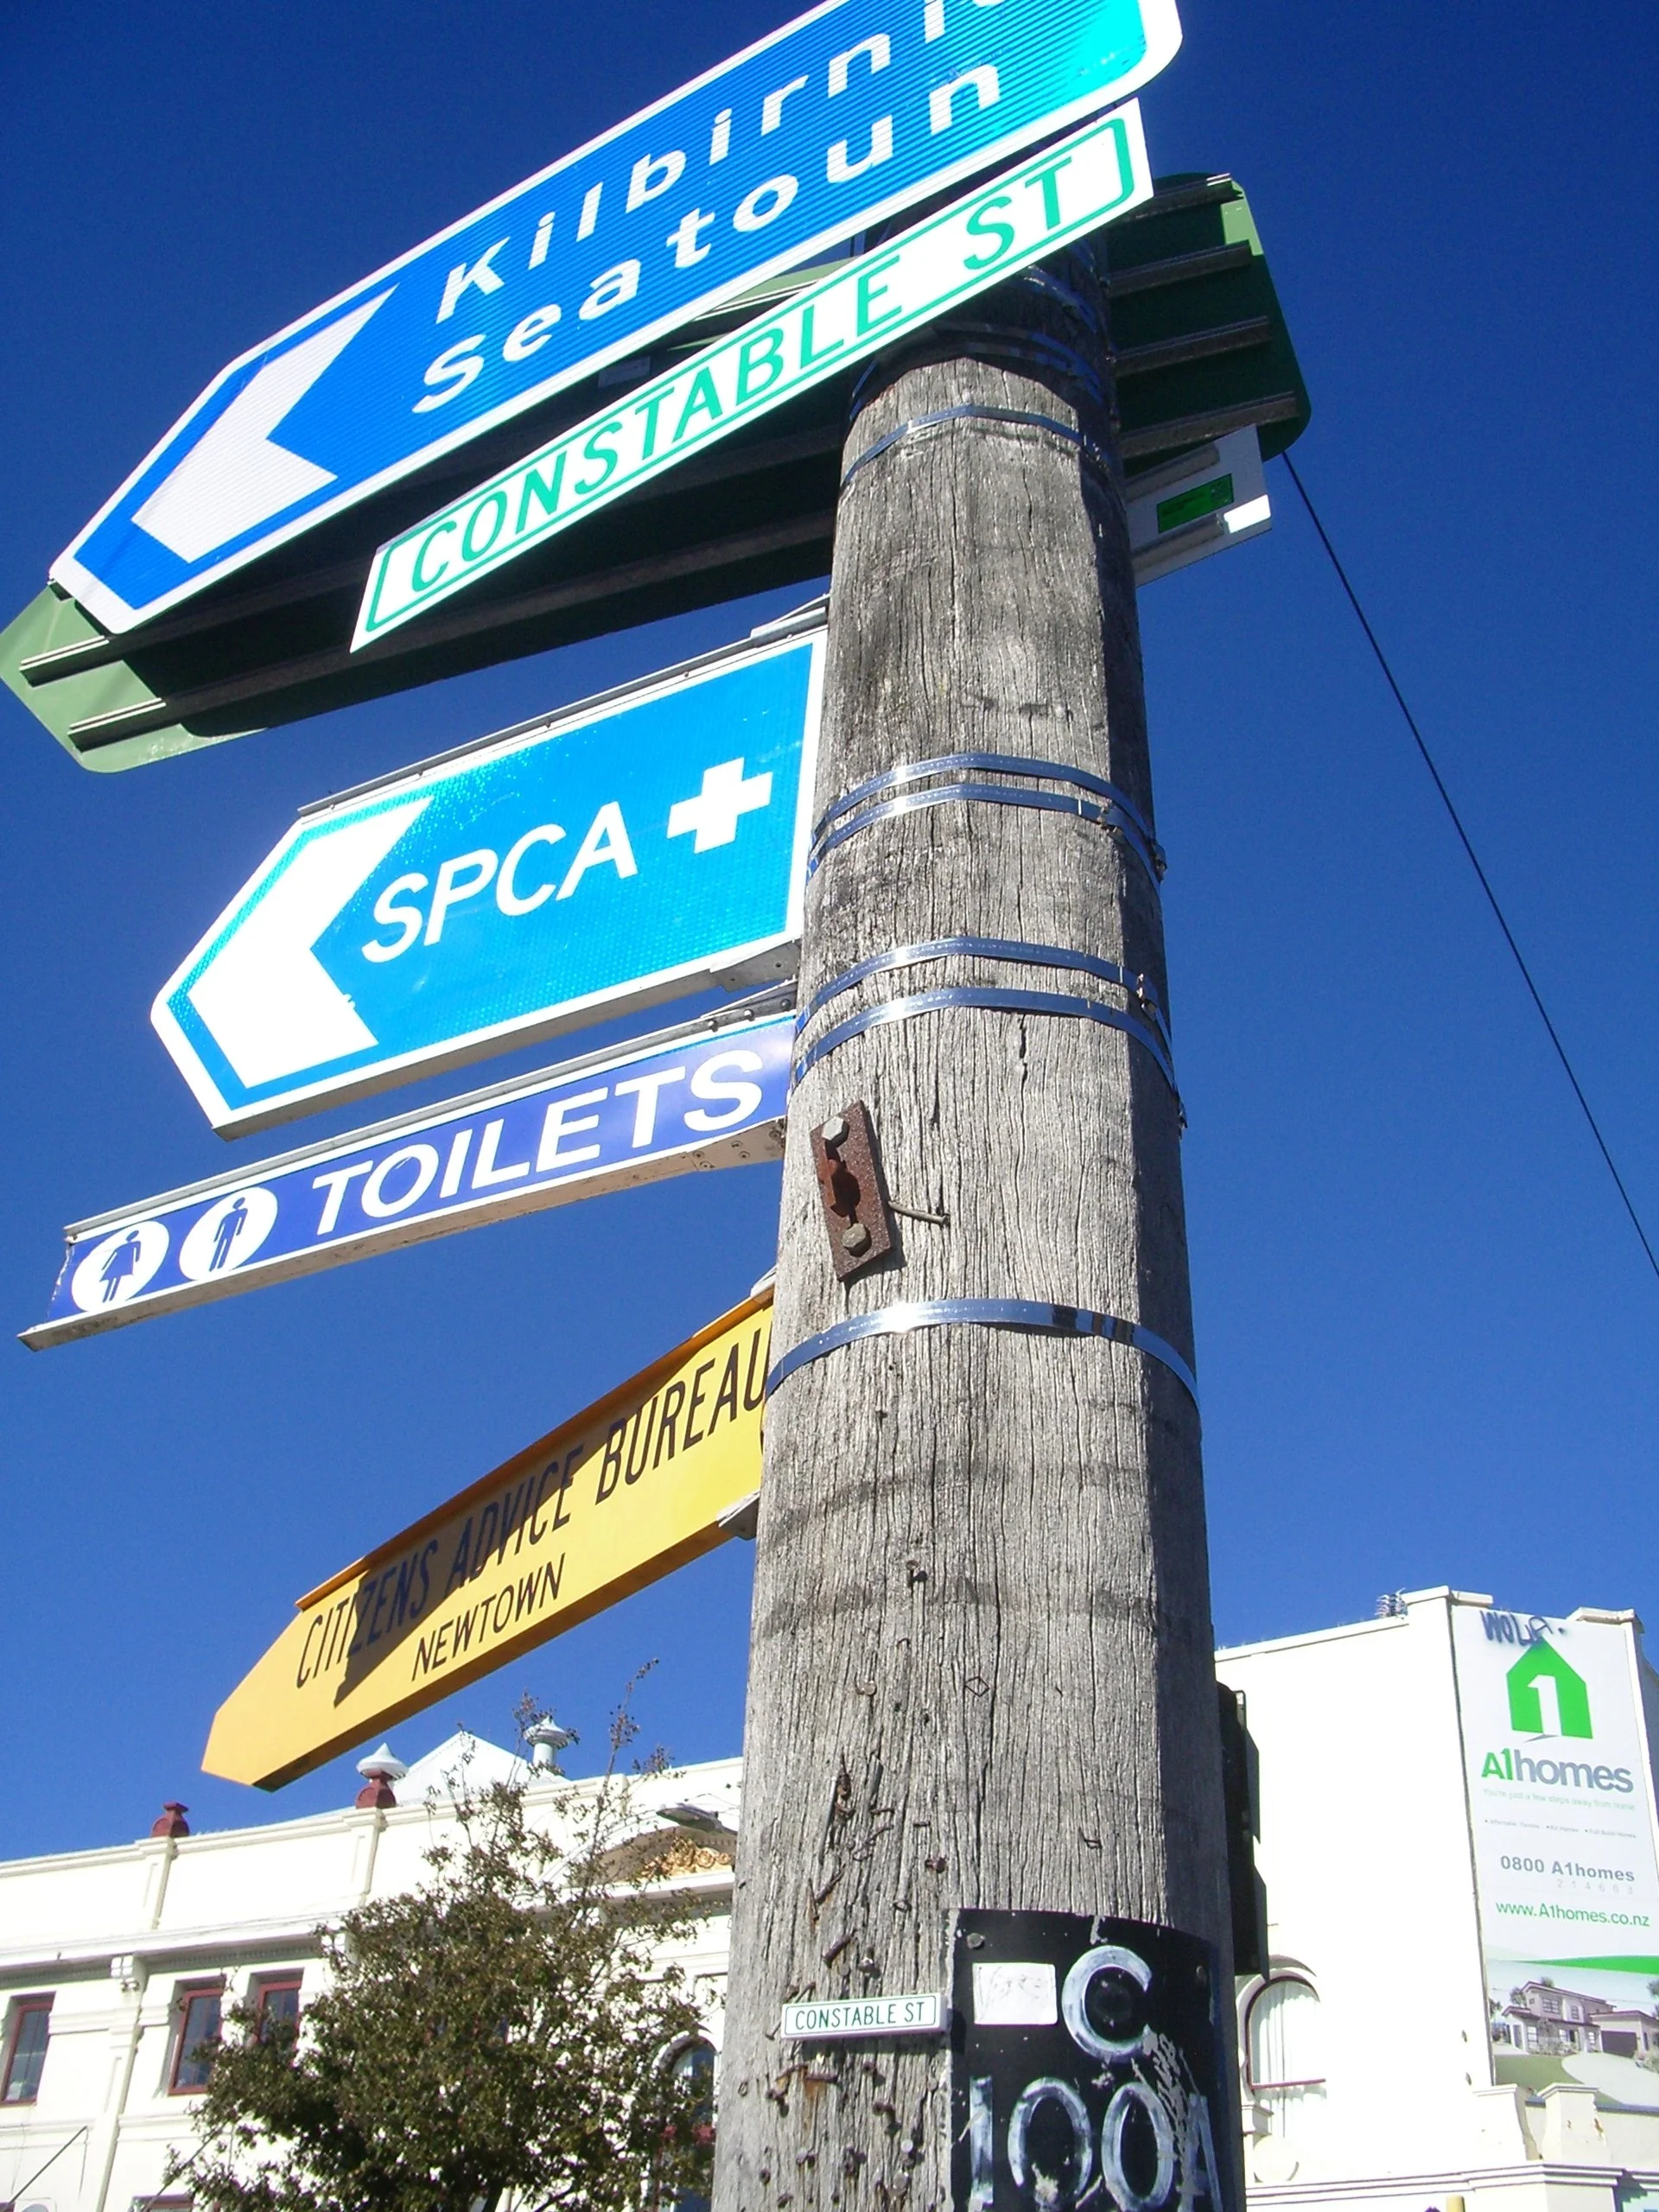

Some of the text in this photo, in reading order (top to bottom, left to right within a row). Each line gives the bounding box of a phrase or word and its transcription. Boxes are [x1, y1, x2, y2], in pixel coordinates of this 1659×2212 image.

[436, 0, 1005, 323] Kilbirni
[412, 64, 1001, 414] Seatoun
[410, 156, 1073, 594] CONSTABLE ST
[361, 801, 639, 963] SPCA
[312, 1049, 763, 1234] TOILETS
[296, 1321, 773, 1688] CITIZENS ADVICE BUREAU
[412, 1553, 566, 1681] NEWTOWN
[1481, 1748, 1635, 1794] A1homes
[1495, 1901, 1651, 1928] www.A1homes.co.nz
[1500, 1855, 1636, 1883] 0800 A1homes
[795, 2001, 925, 2031] CONSTABLE ST
[1061, 1944, 1153, 2063] C
